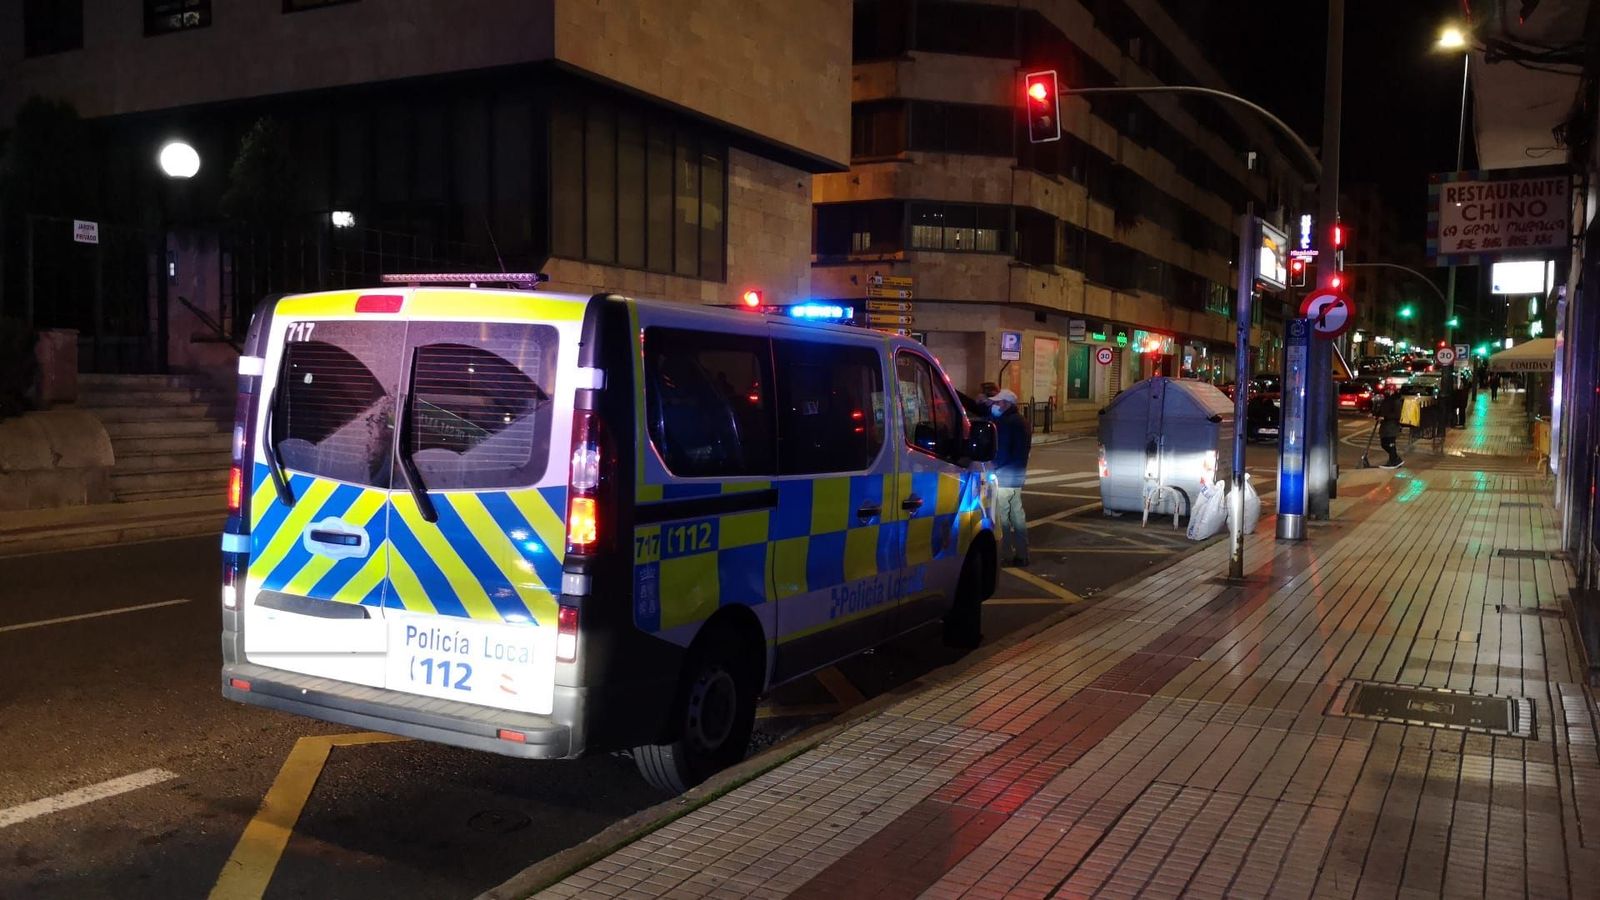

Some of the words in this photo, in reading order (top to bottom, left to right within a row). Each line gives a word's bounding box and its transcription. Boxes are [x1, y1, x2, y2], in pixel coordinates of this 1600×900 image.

[1446, 180, 1564, 203] RESTAURANTE
[1461, 199, 1548, 222] CHINO
[1463, 223, 1500, 236] GRAN
[1506, 219, 1565, 233] MURALLA
[287, 322, 315, 342] 717
[1005, 334, 1018, 349] P
[1439, 352, 1452, 360] 30
[1456, 346, 1467, 357] P
[1510, 361, 1548, 370] COMIDAS
[840, 577, 885, 616] Policía
[406, 624, 470, 655] Policía
[483, 635, 536, 665] Local
